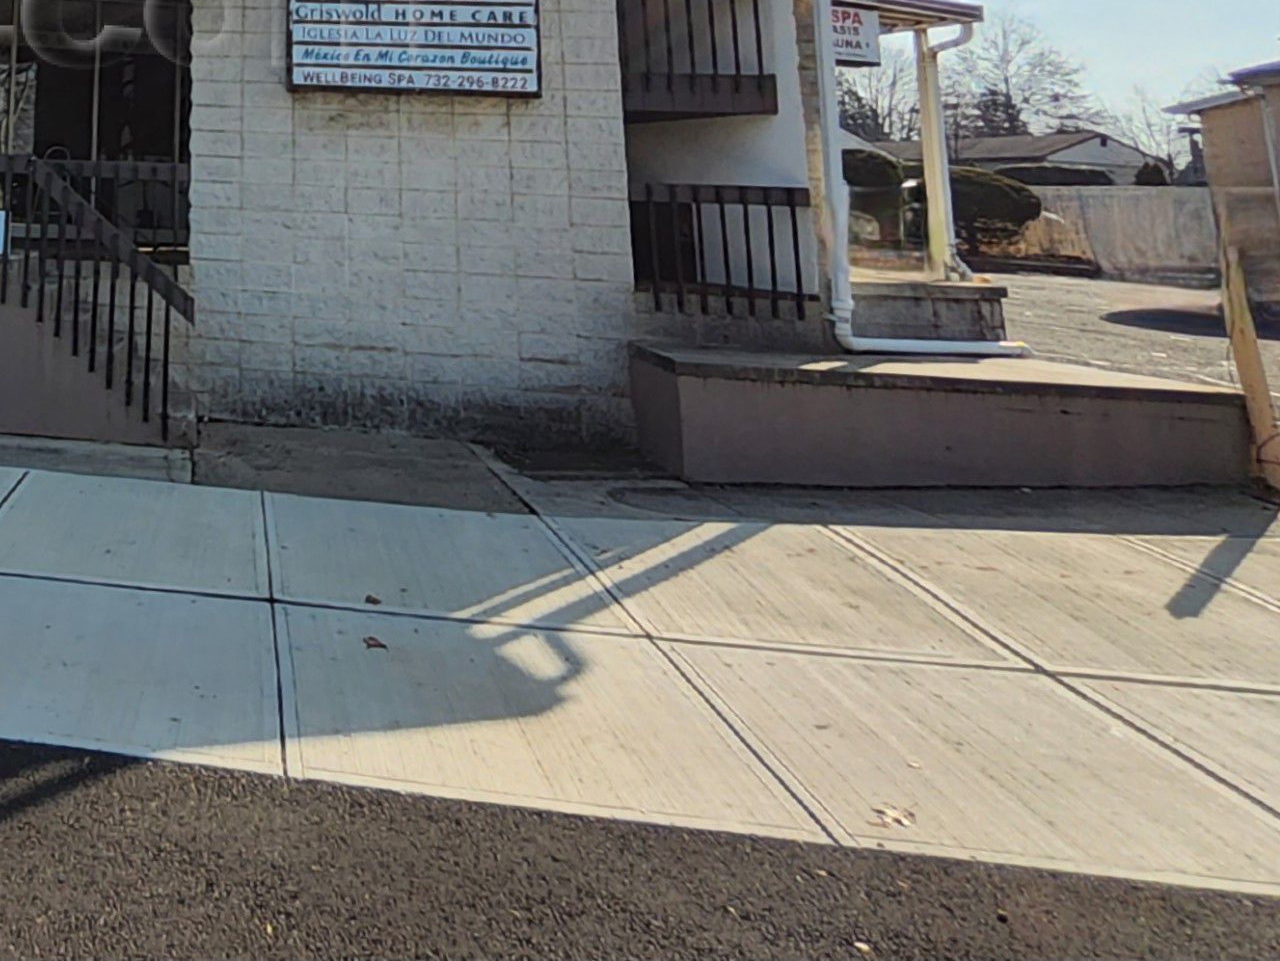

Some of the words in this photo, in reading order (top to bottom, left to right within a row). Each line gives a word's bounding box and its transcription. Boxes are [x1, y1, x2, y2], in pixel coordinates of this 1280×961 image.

[295, 3, 382, 21] Griswold
[394, 9, 458, 21] HOME
[471, 10, 528, 23] CARE
[830, 9, 864, 26] SPA
[302, 26, 359, 39] IGLESIA
[365, 27, 383, 40] LA
[389, 27, 418, 41] LUZ
[424, 29, 455, 43] DEL
[459, 31, 526, 44] MUNDO
[832, 25, 861, 36] ASIS
[353, 49, 371, 62] En
[374, 49, 394, 63] Mi
[460, 51, 528, 68] Boutique
[302, 71, 383, 85] WELLBEING
[388, 73, 416, 85] SPA
[424, 74, 528, 89] 732-296-8222
